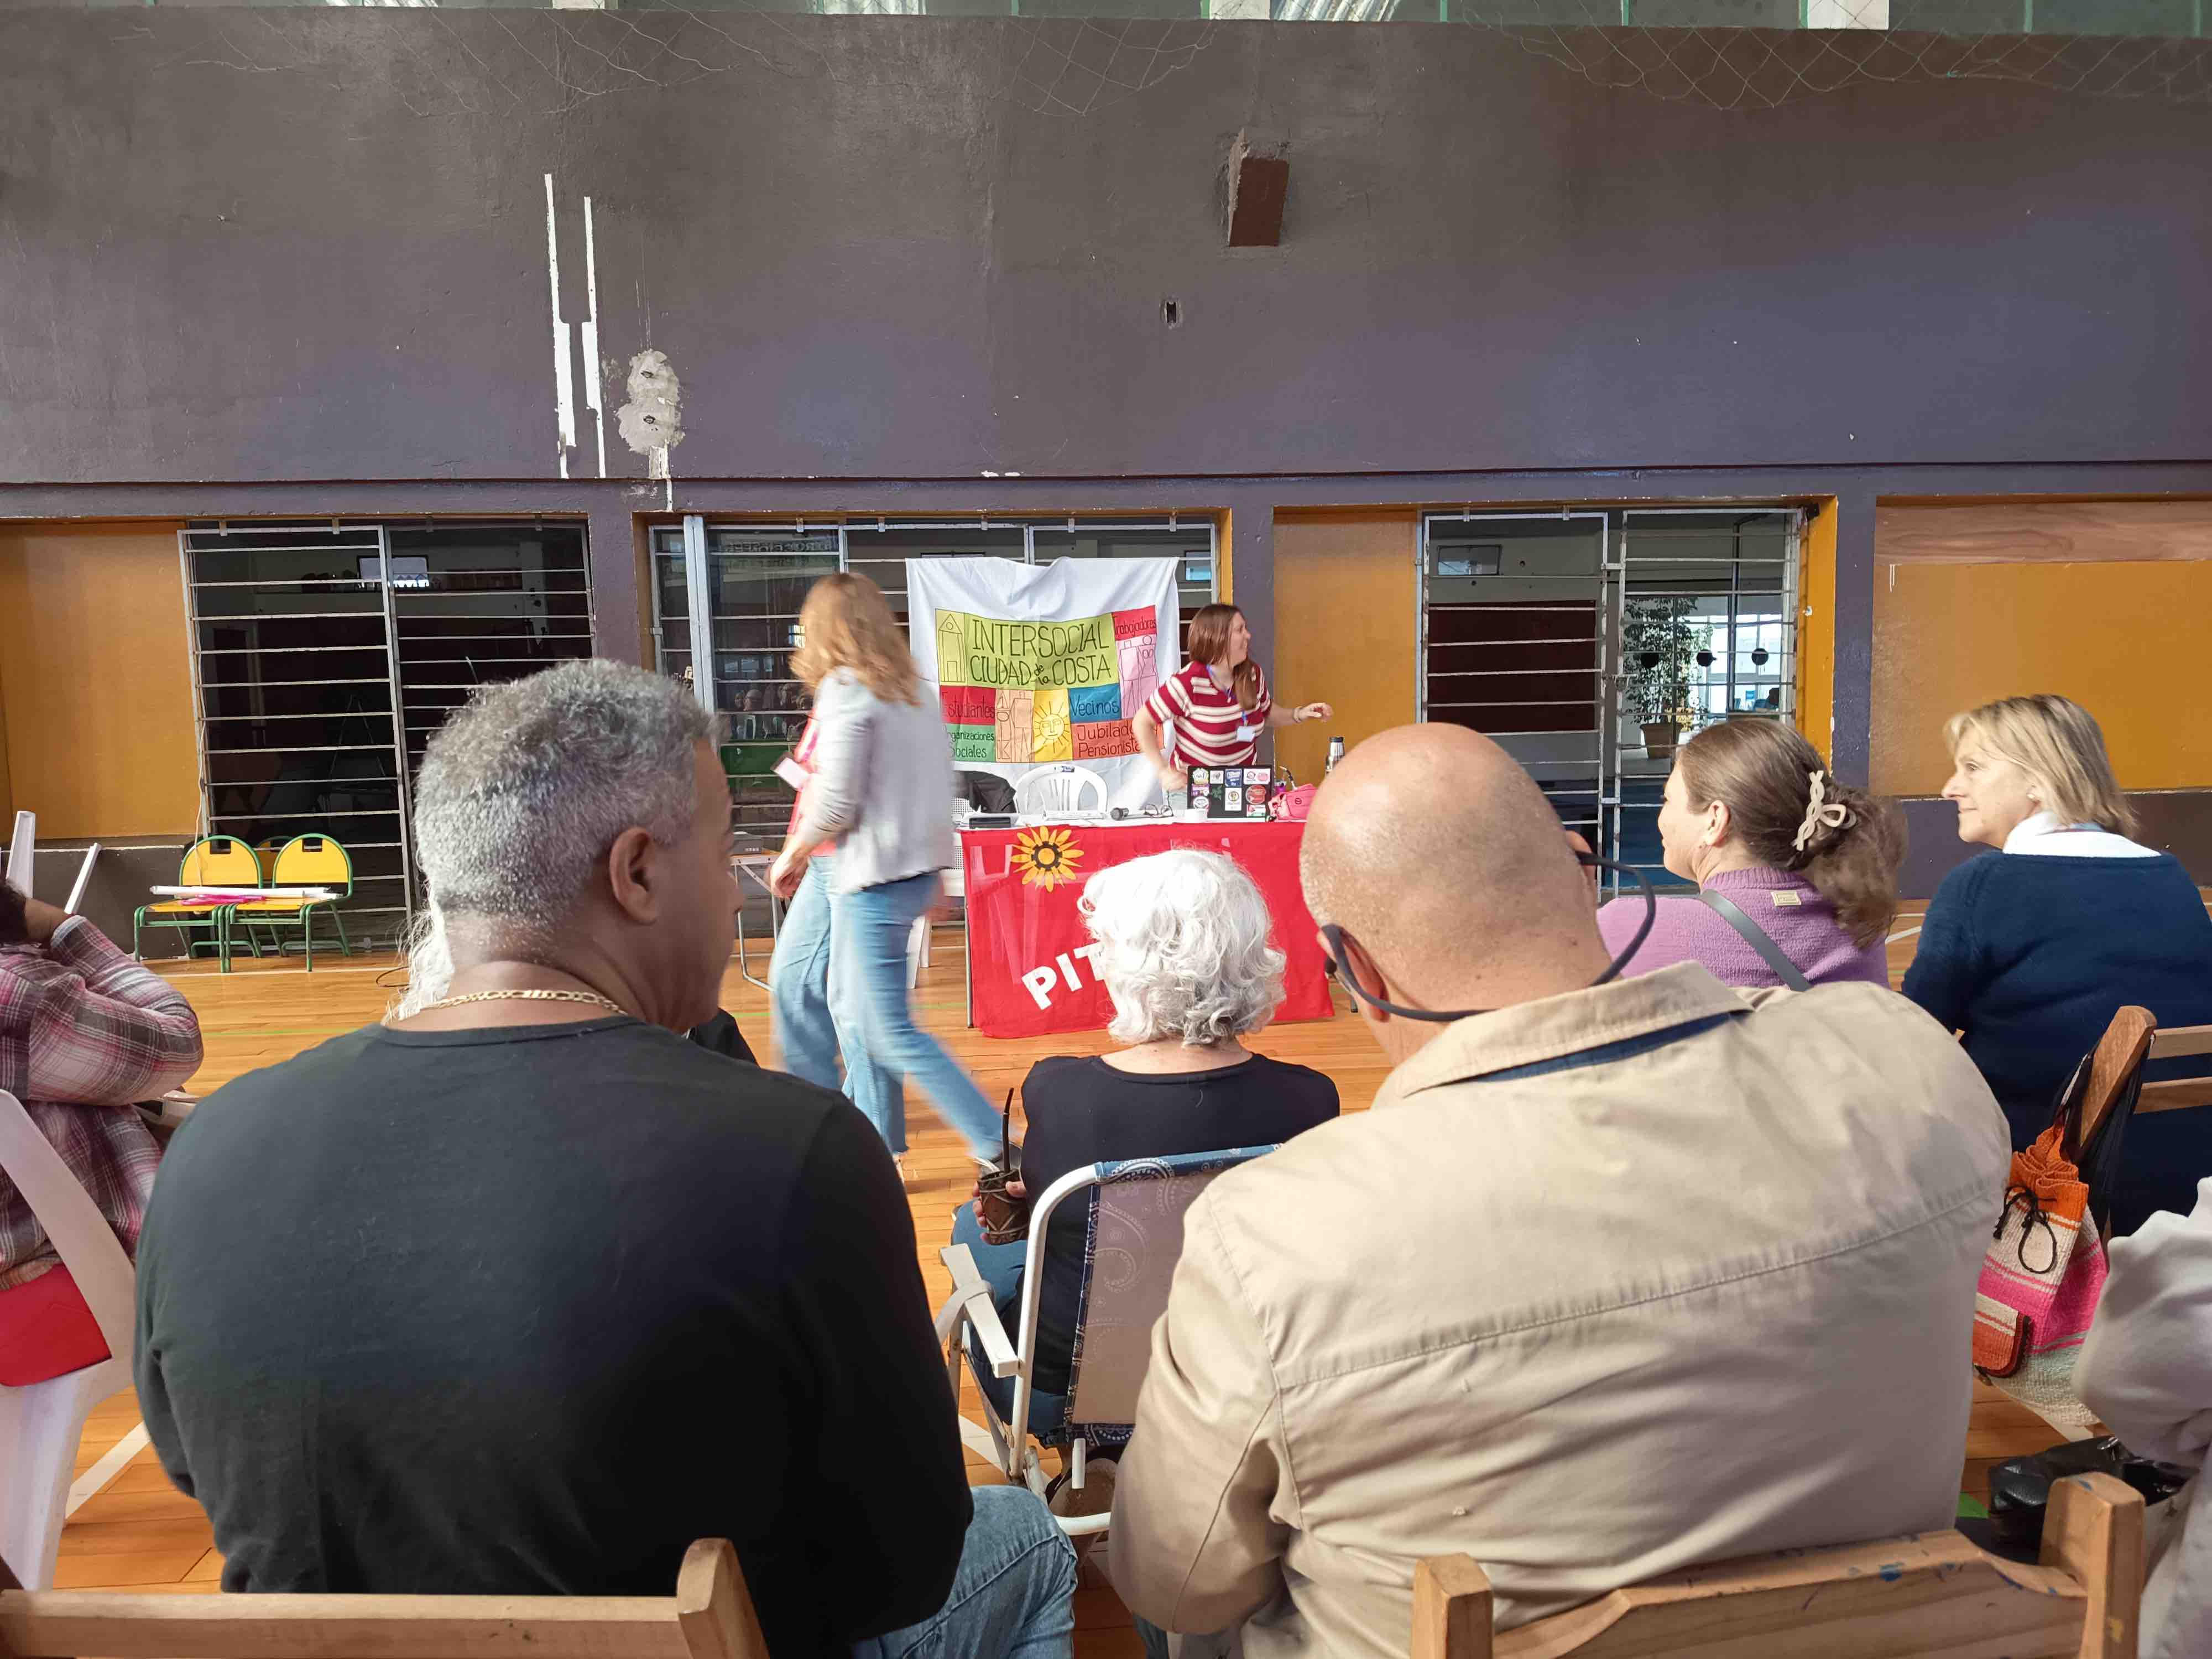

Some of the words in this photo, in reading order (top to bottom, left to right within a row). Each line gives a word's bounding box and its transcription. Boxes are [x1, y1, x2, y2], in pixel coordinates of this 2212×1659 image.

[973, 619, 1109, 658] INTERSOCIAL
[970, 655, 1032, 686] CIUDAD
[1034, 663, 1045, 676] de
[1038, 674, 1051, 686] la
[1052, 654, 1112, 686] COSTA
[1070, 694, 1120, 716] Vecinos
